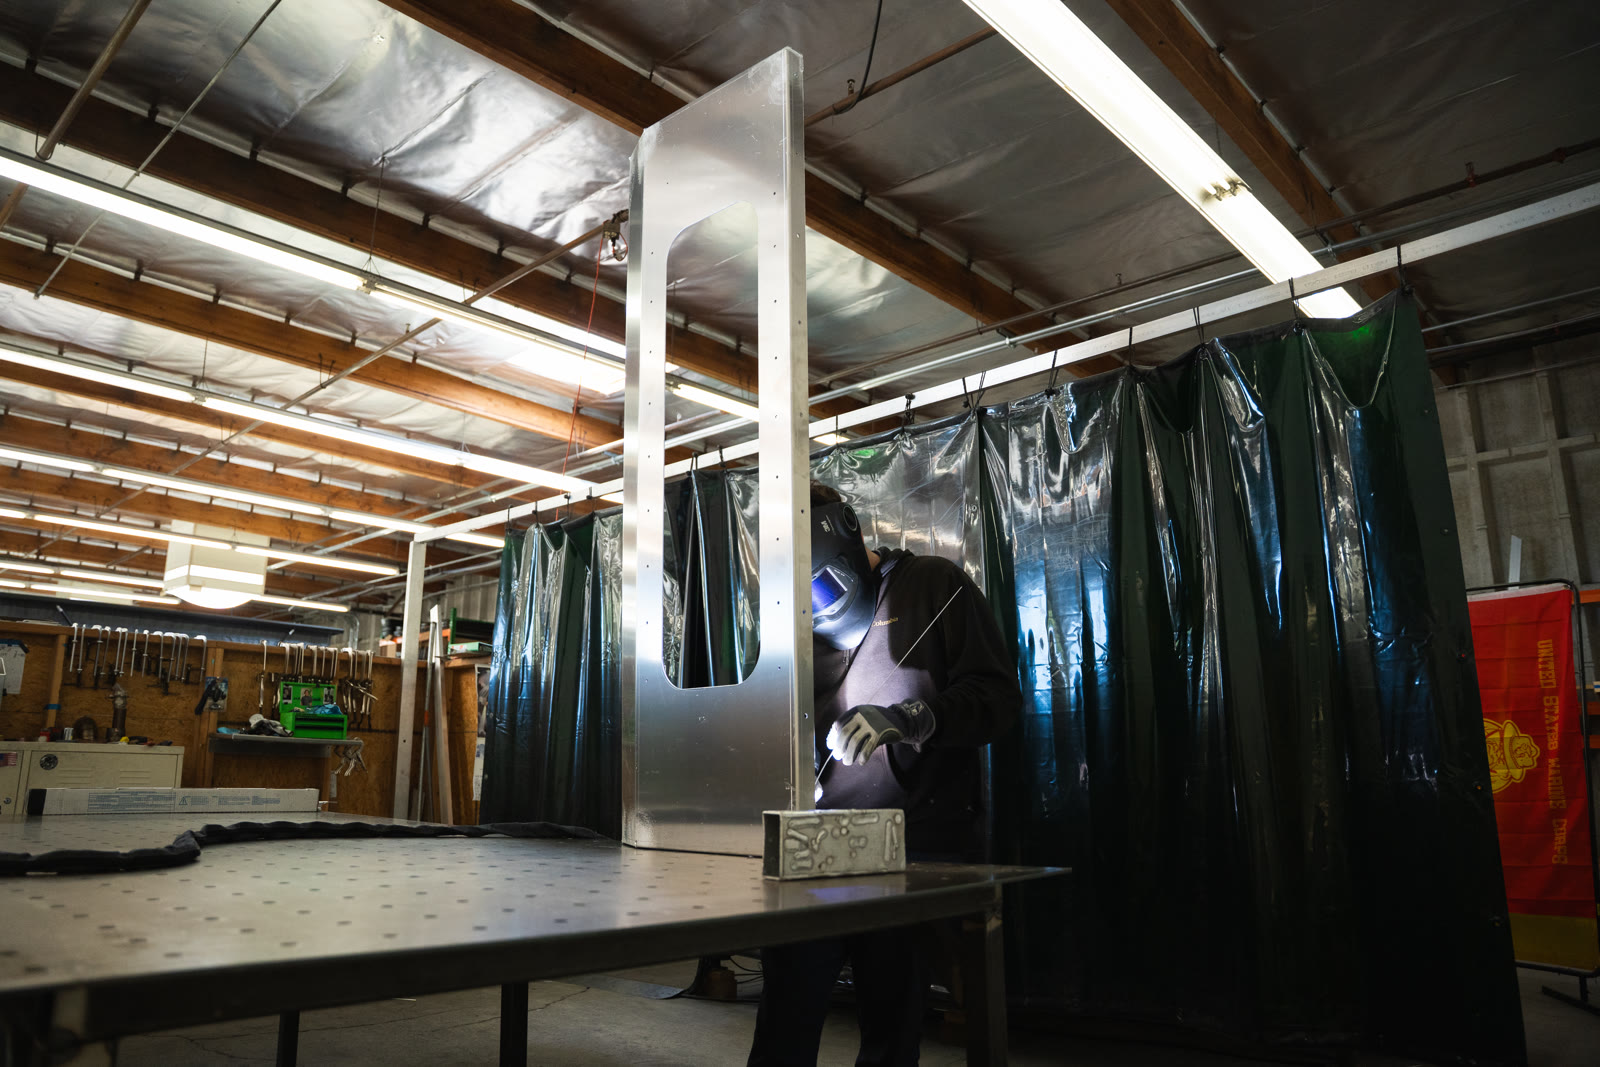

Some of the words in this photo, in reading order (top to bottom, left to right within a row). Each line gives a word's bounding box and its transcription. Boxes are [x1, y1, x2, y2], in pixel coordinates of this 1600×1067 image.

[1537, 639, 1556, 688] UNITED
[1543, 695, 1560, 750] STATES
[1548, 757, 1567, 809] MARINE
[1552, 818, 1568, 865] CORPS
